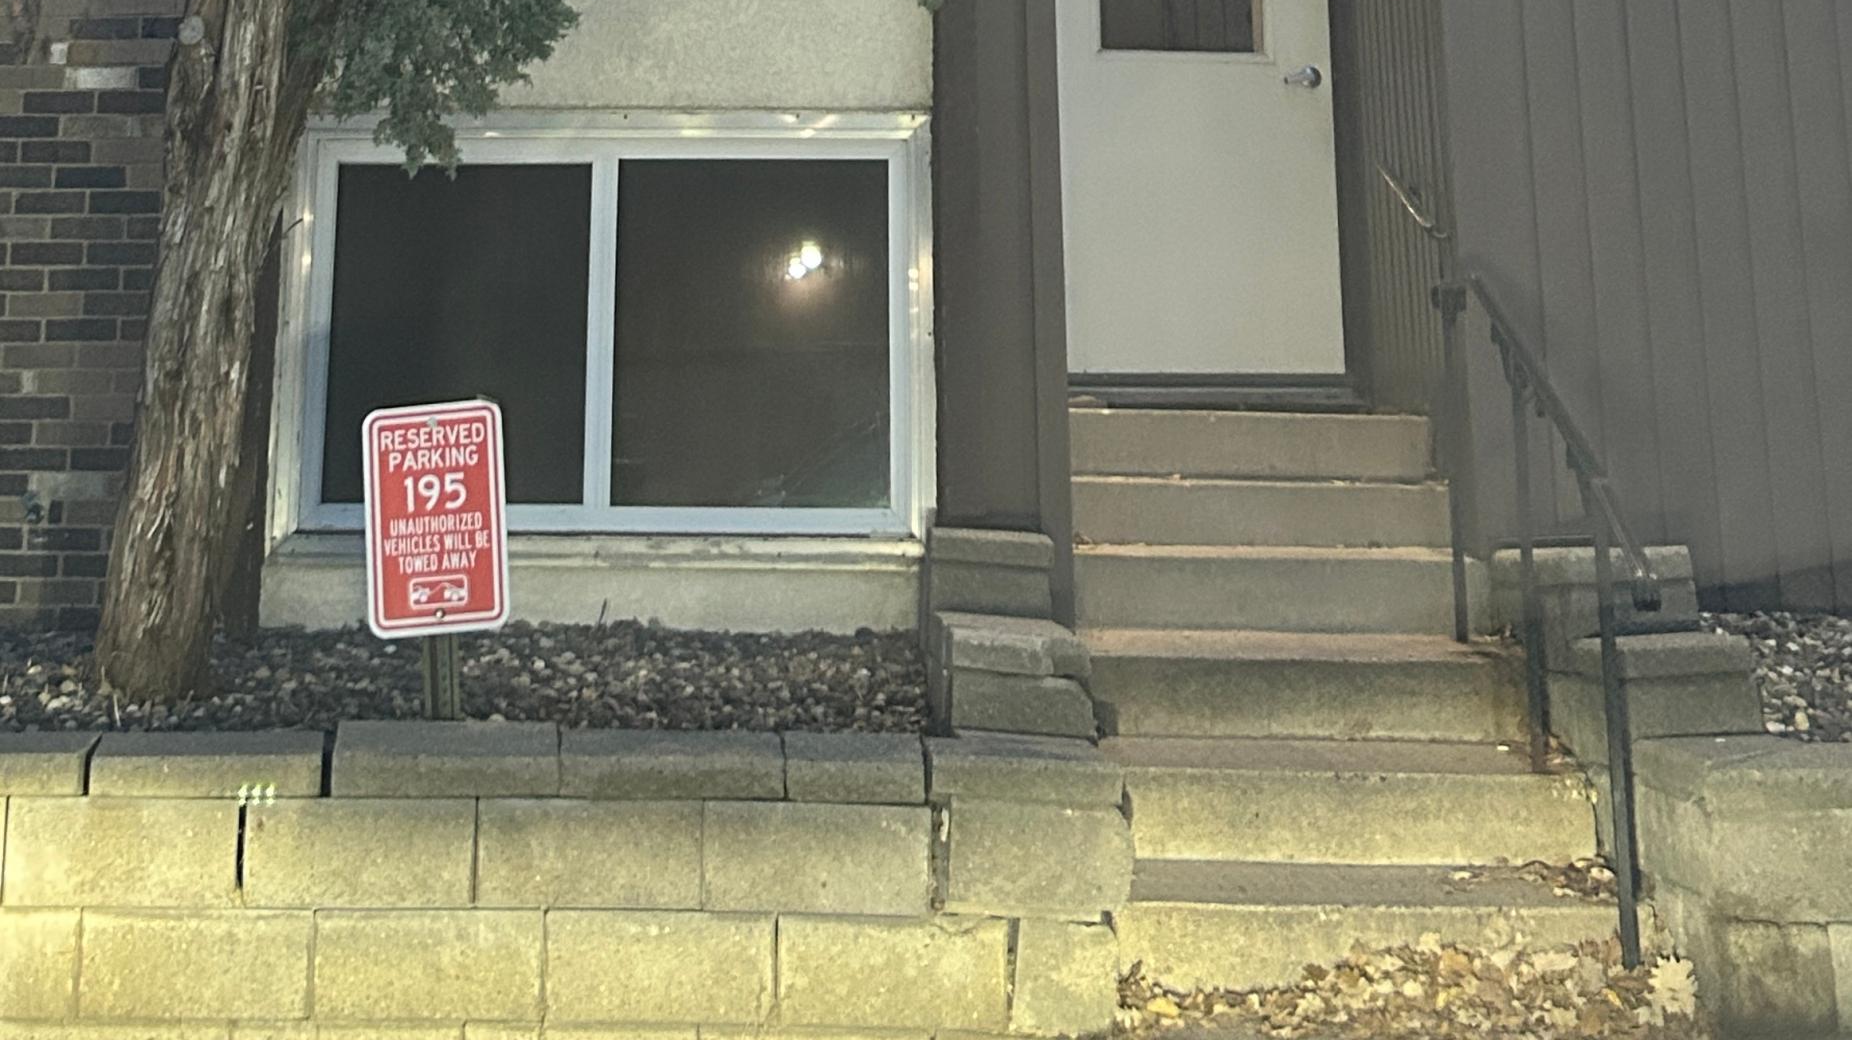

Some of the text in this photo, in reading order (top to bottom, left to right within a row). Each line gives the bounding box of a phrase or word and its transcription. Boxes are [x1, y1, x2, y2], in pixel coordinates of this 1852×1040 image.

[381, 422, 485, 451] RESERVED
[389, 445, 479, 473] PARKING
[404, 472, 467, 513] 195
[390, 511, 483, 536] UNAUTHORIZED
[384, 530, 491, 556] VEHICLES WILL BE
[399, 550, 478, 575] TOWED AWAY
